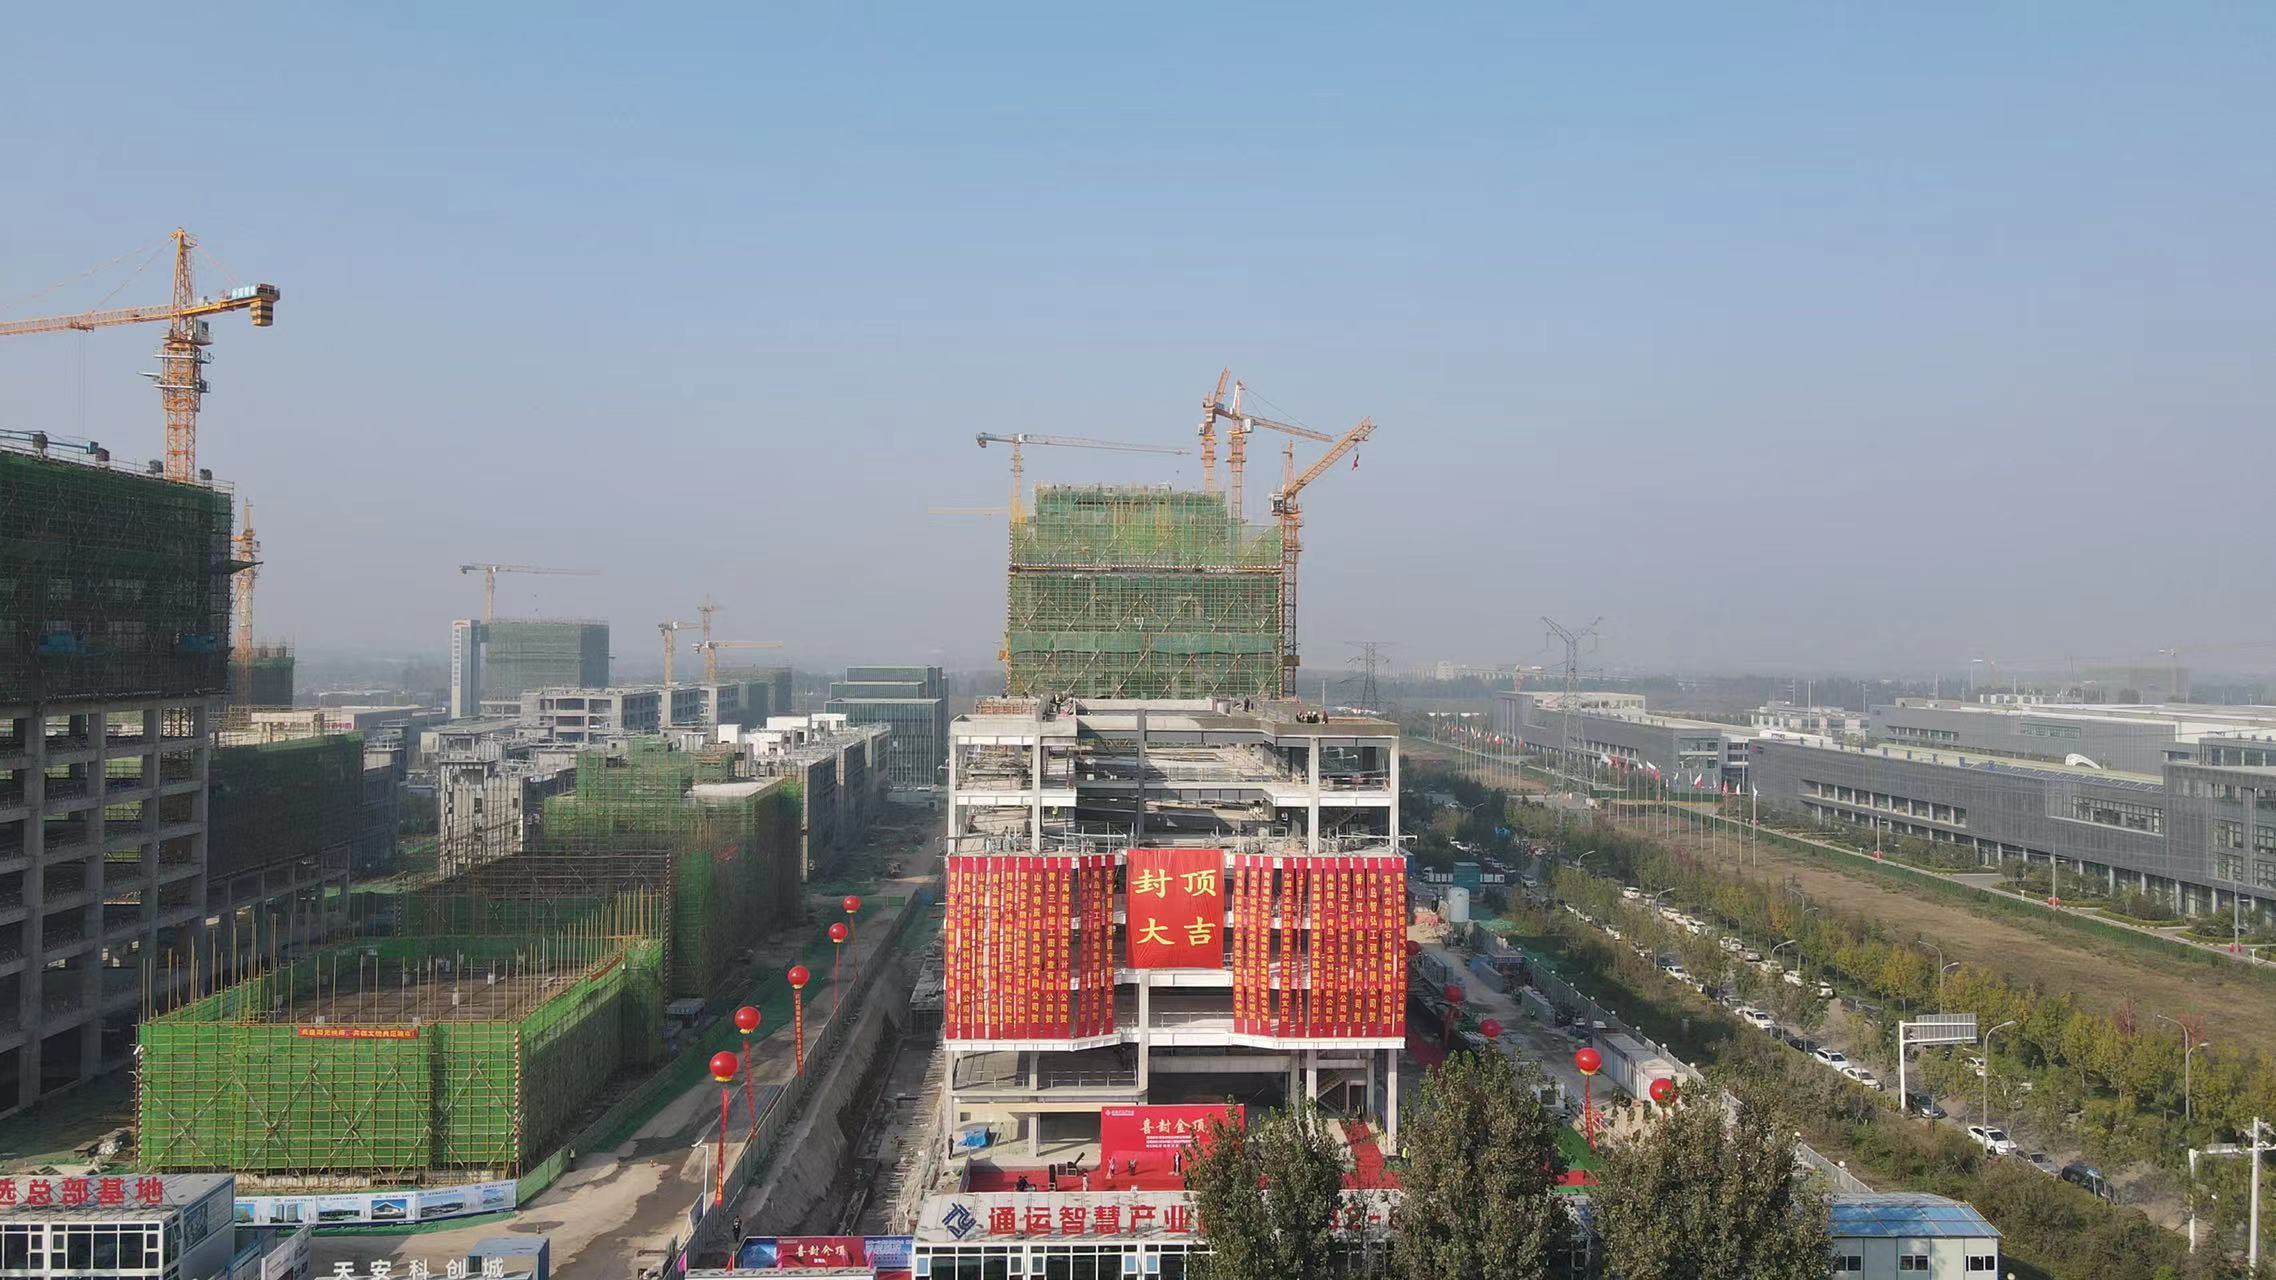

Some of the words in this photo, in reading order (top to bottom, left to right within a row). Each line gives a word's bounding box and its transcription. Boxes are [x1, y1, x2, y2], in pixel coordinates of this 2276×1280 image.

[1131, 868, 1217, 899] 封顶
[1136, 916, 1217, 946] 大吉
[1354, 874, 1363, 1022] 香山红叶建设有限公司贺
[988, 1205, 1206, 1235] 通运智慧产业
[333, 1258, 505, 1280] 天安科创城
